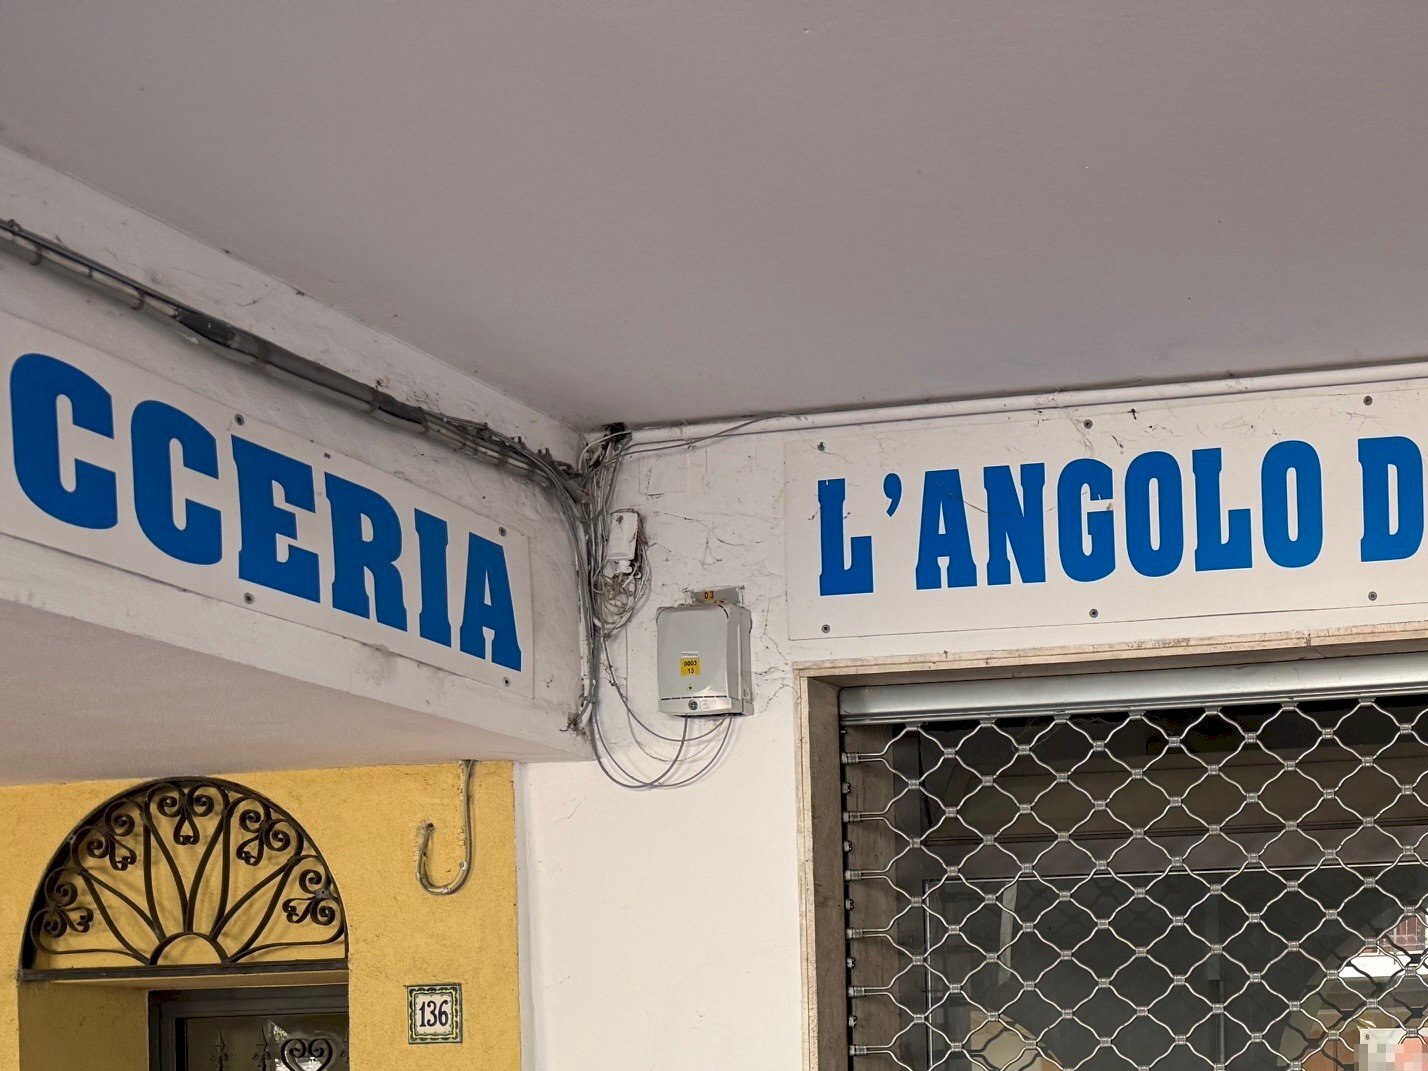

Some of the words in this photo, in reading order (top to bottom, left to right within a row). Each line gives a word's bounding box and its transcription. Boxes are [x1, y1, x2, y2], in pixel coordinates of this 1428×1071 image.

[10, 352, 522, 672] CCERIA
[817, 439, 1324, 597] L'ANGOLO
[419, 999, 449, 1028] 136
